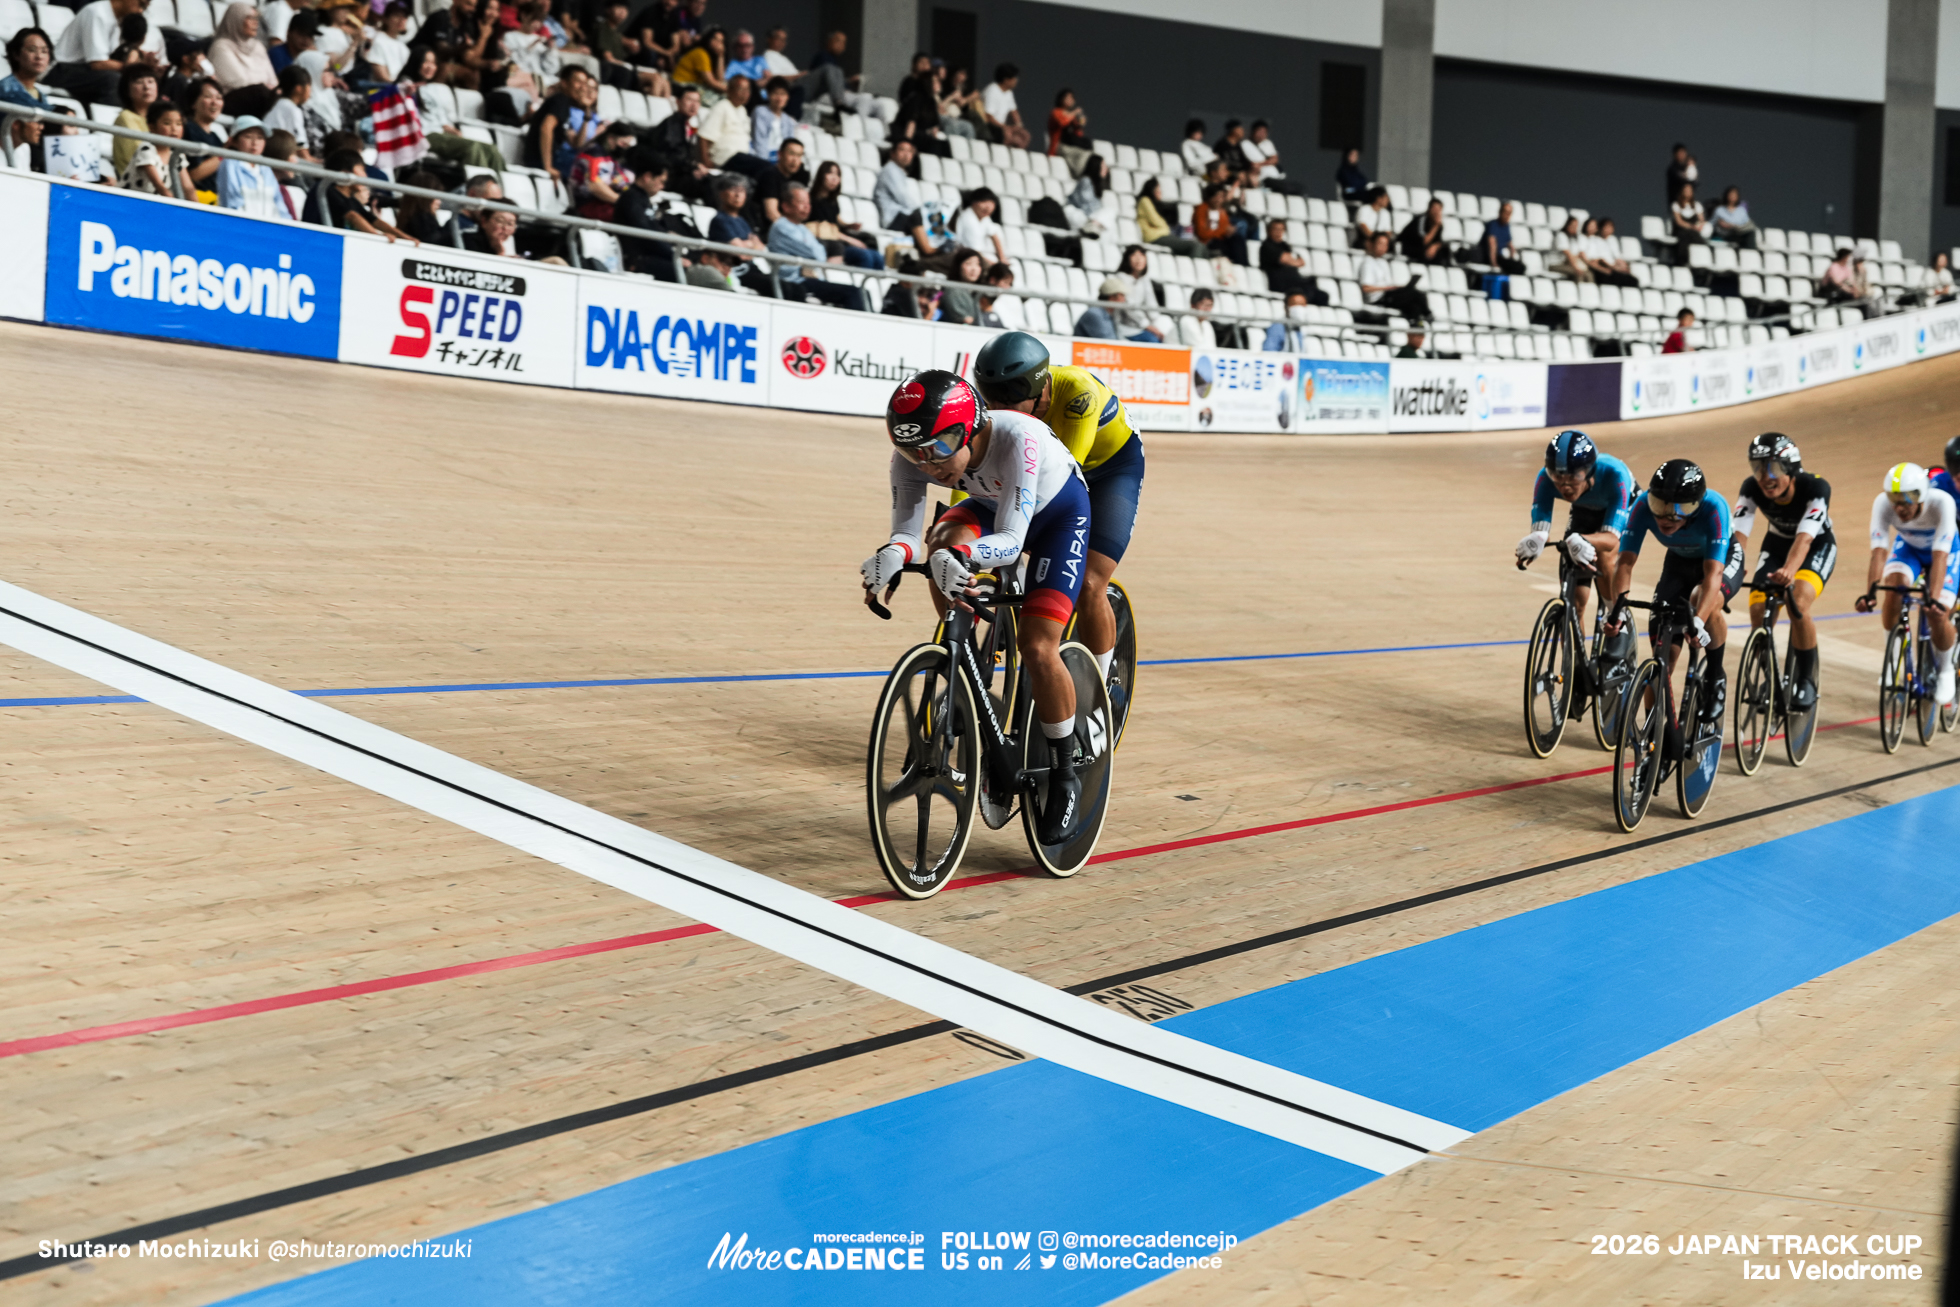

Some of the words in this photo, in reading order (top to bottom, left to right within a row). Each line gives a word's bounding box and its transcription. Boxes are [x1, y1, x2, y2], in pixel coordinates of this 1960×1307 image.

[78, 219, 316, 323] Panasonic
[390, 285, 523, 358] SPEED
[435, 341, 523, 372] チャンネル
[586, 305, 758, 384] DIA-COMPE
[1393, 377, 1468, 416] wattbike
[994, 545, 1019, 559] Cyclers
[1062, 516, 1088, 590] JAPAN
[964, 638, 1005, 746] BRIDGESTONE
[1091, 984, 1195, 1022] 250
